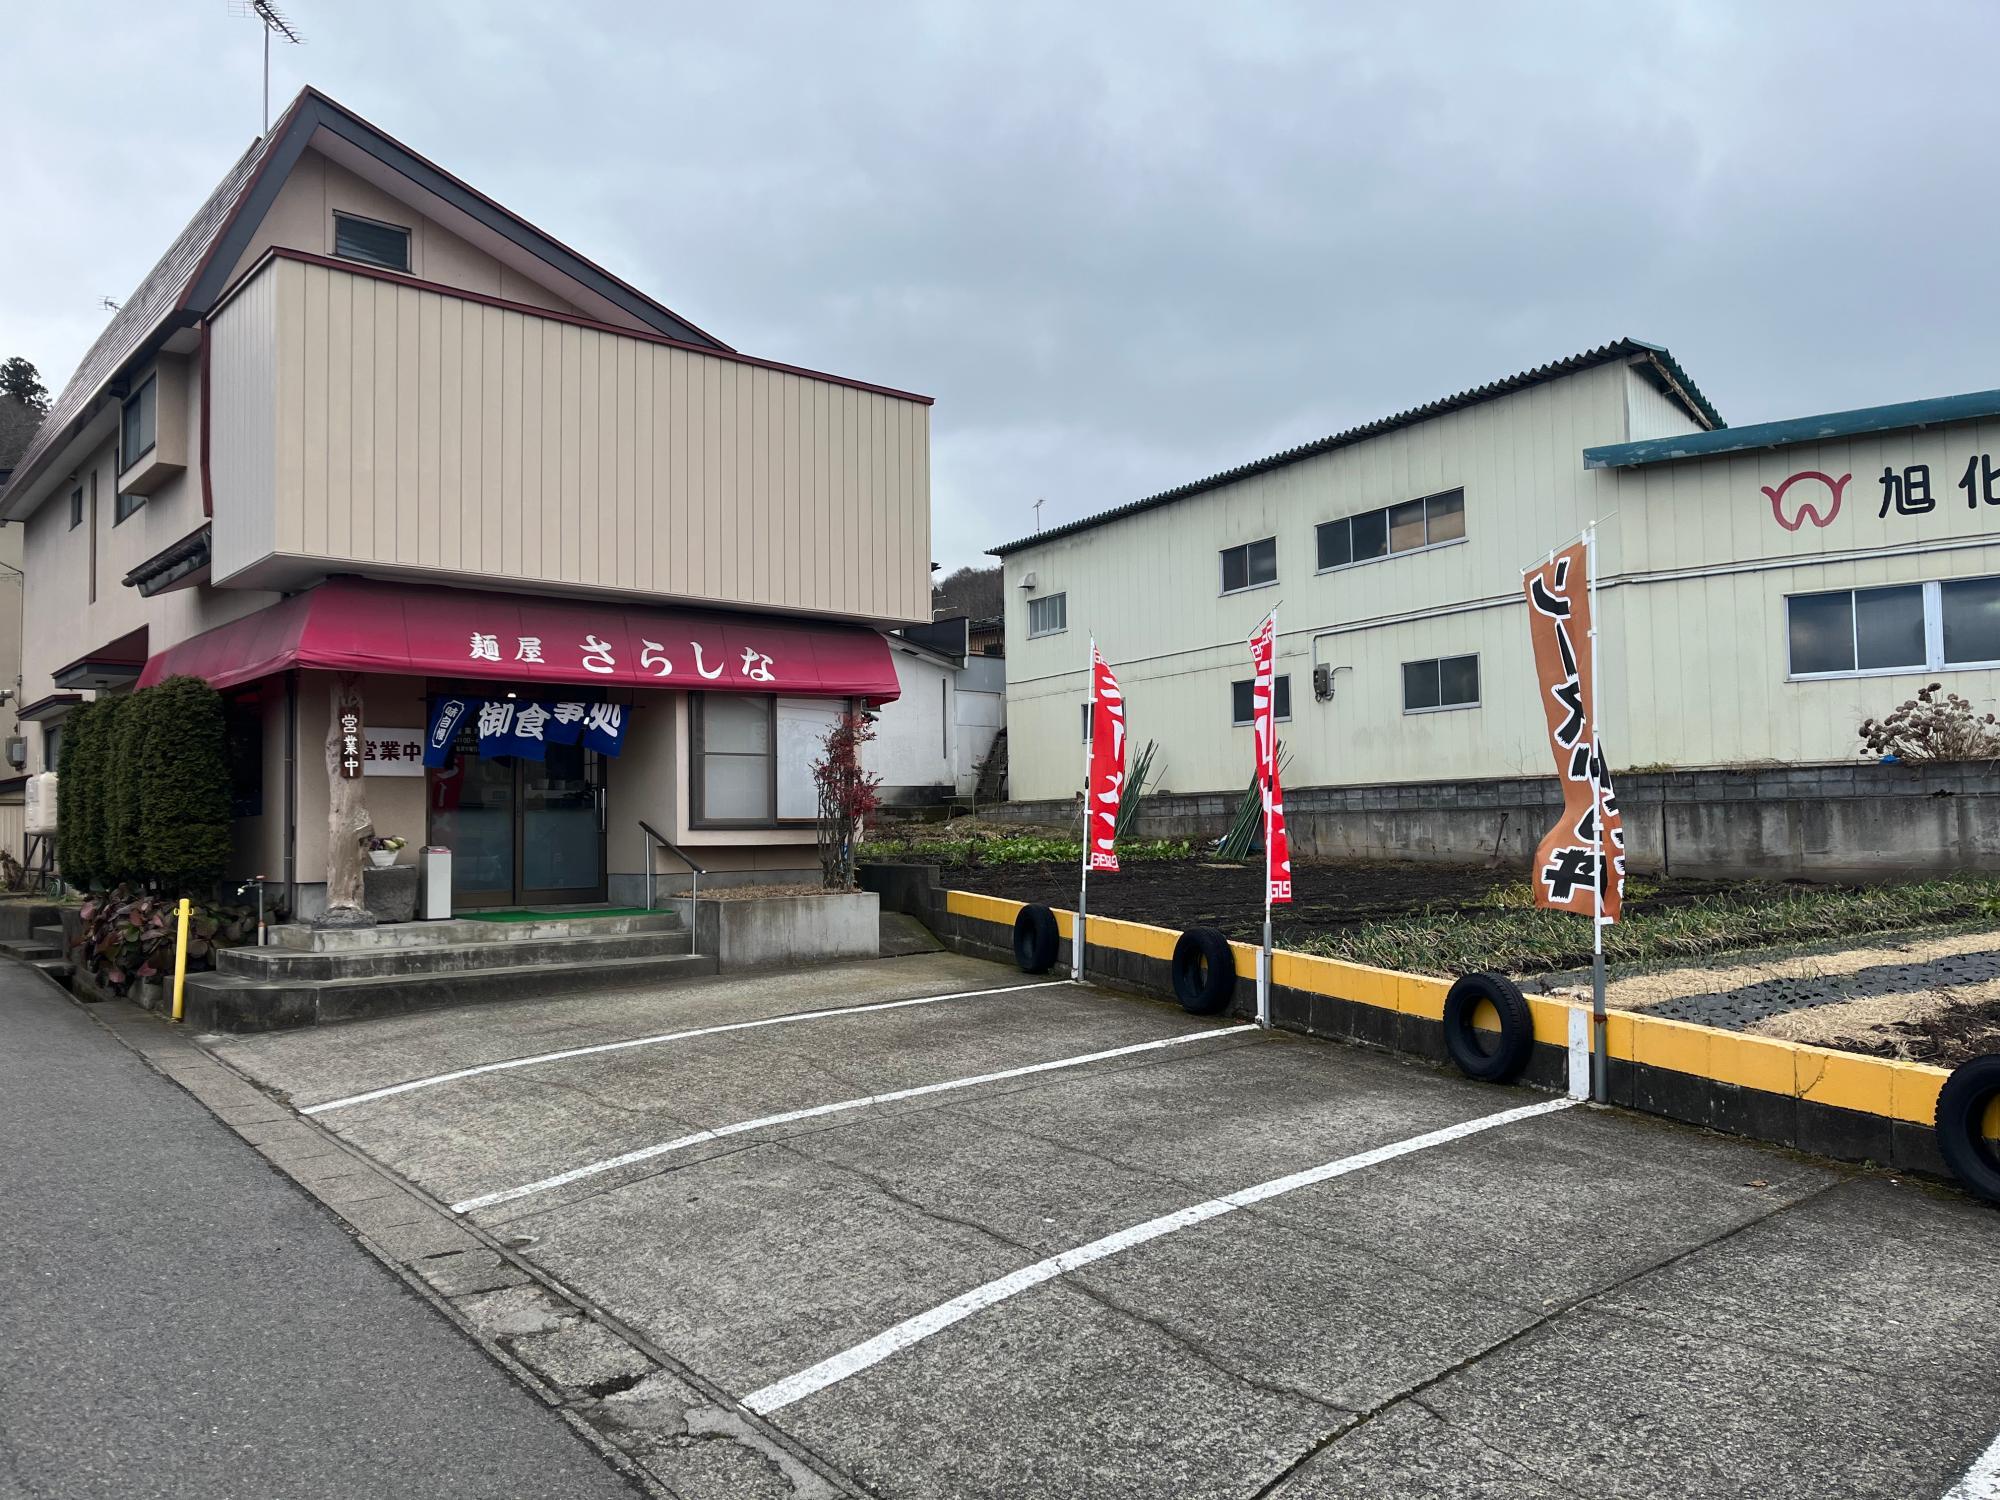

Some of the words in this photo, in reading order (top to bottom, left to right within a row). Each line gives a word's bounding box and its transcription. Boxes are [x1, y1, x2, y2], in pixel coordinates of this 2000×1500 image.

[469, 631, 545, 664] 麺屋
[579, 634, 776, 682] さらしな
[341, 713, 359, 777] 営業中
[477, 701, 621, 741] 御食事処
